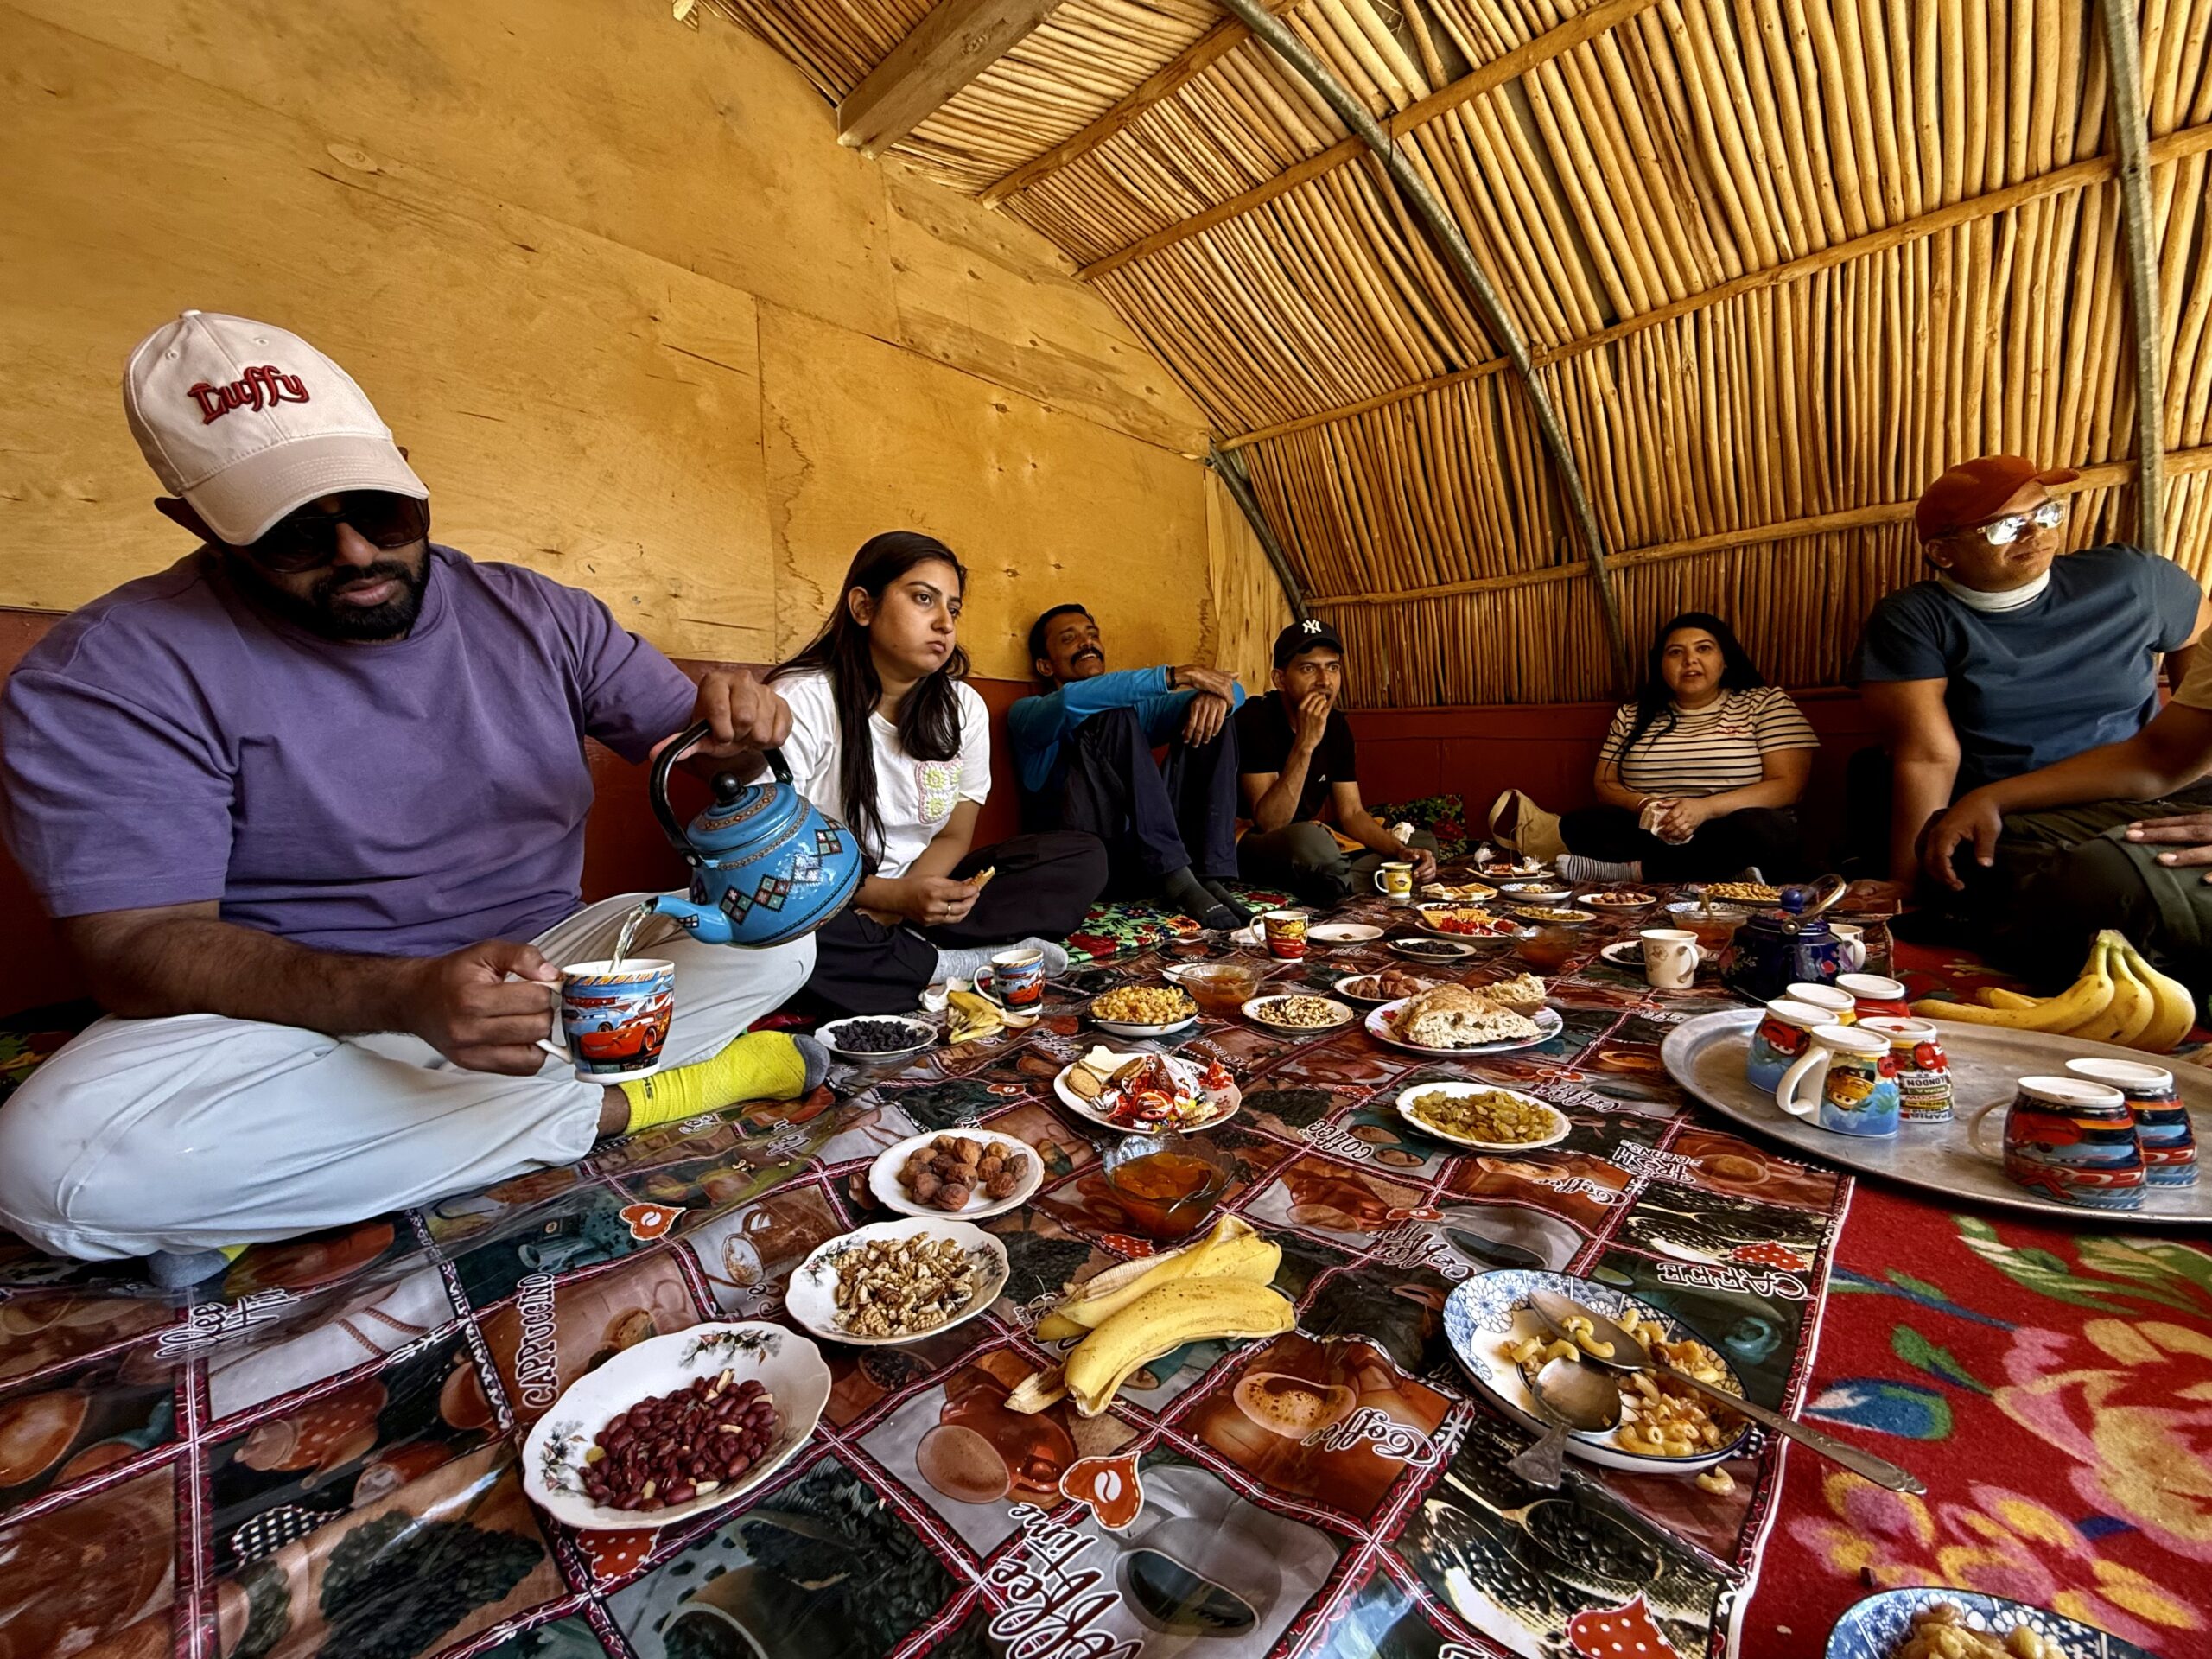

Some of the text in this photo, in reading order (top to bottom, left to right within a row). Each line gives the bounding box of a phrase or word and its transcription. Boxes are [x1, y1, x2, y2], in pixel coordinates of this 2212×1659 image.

[187, 365, 309, 425] Luffy
[1907, 1077, 1945, 1086] LONDON
[516, 1272, 560, 1408] CAPPUCCINO
[1300, 1406, 1440, 1467] Coffee
[1007, 1502, 1099, 1588] Time
